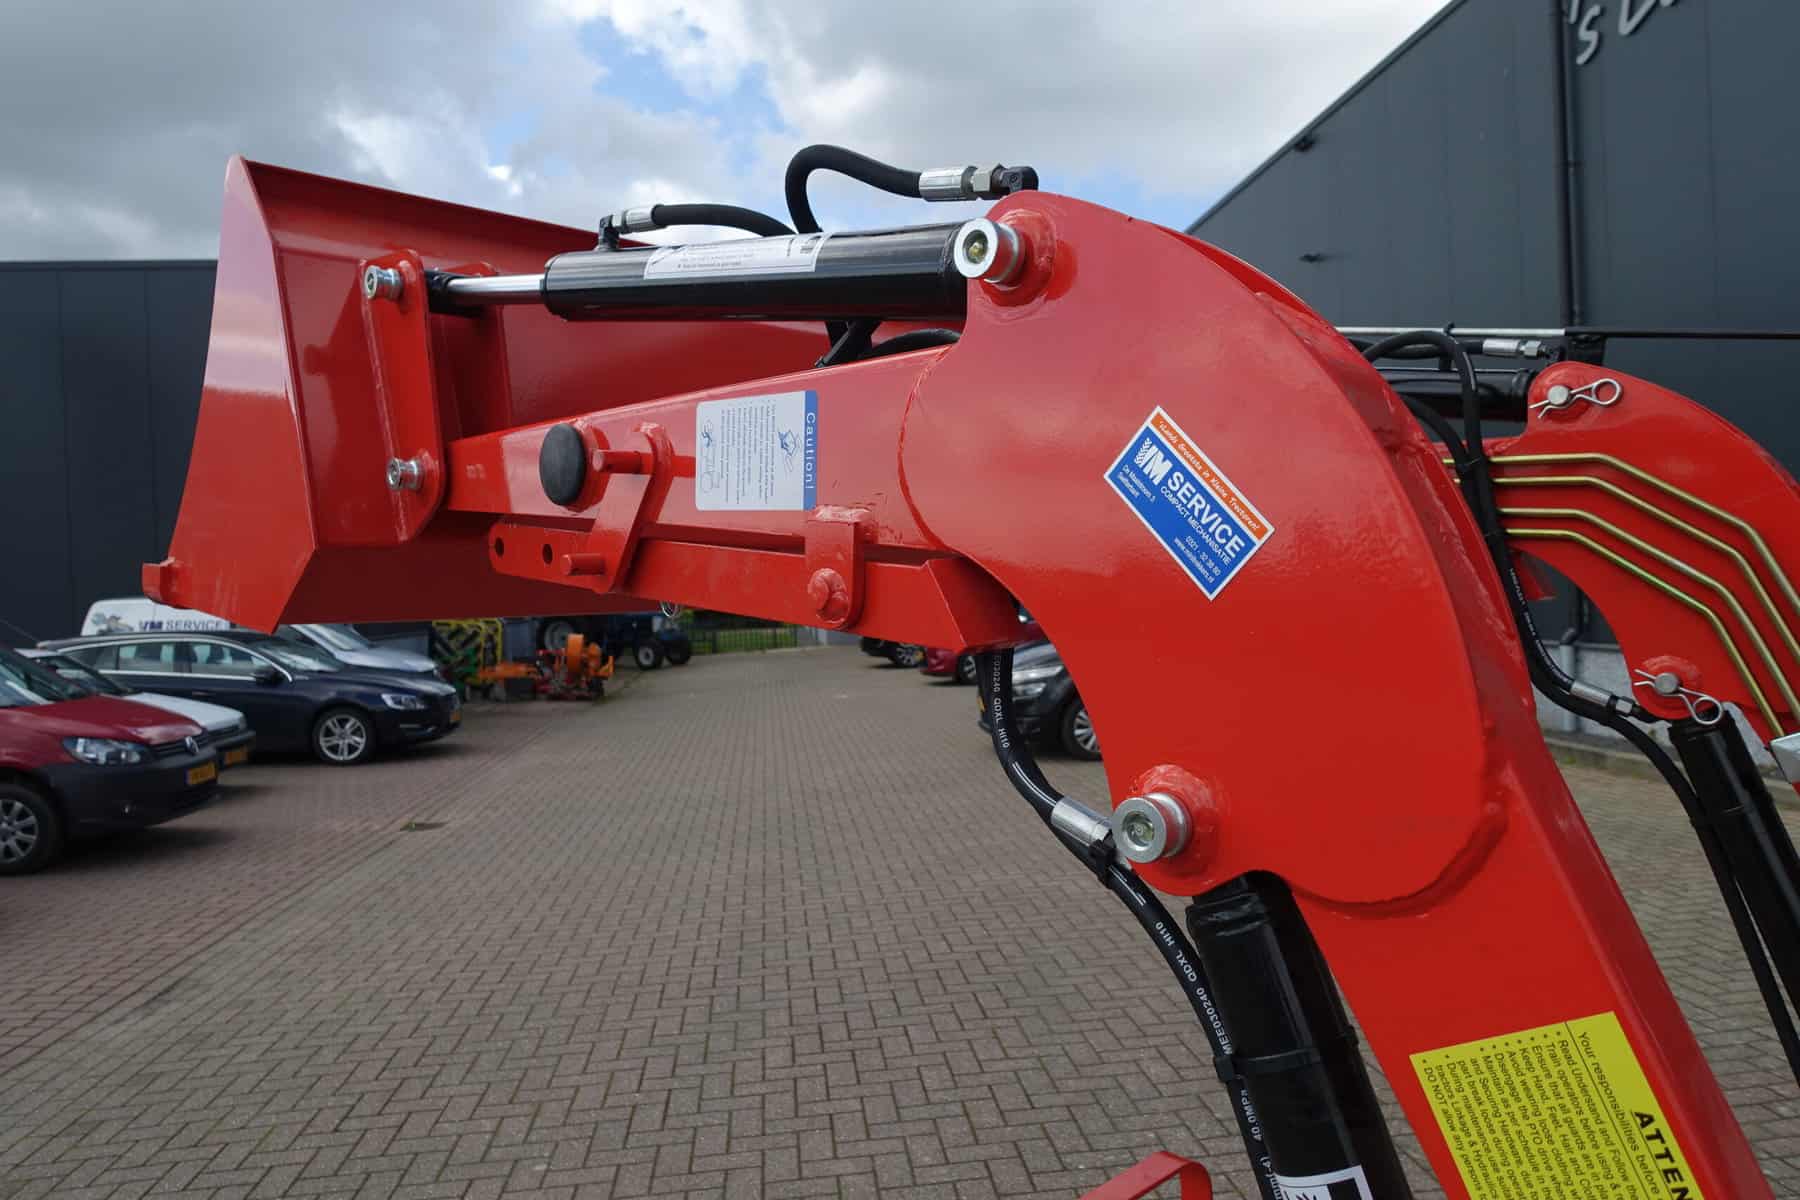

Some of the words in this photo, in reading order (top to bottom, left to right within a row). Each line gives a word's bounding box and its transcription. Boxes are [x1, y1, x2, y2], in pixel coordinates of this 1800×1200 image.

[805, 412, 816, 489] Caution!
[1159, 484, 1189, 519] COMPACT
[1186, 515, 1231, 566] MECHANISATIE
[1165, 468, 1246, 559] SERVICE
[1175, 950, 1197, 982] QDXL
[1422, 1066, 1437, 1082] DO
[1430, 1084, 1447, 1106] NOT
[1440, 1107, 1459, 1132] allow
[1469, 1057, 1485, 1075] and
[1476, 1076, 1504, 1118] Securing
[1531, 1044, 1555, 1079] Ensure
[1548, 1080, 1564, 1100] that
[1434, 1064, 1457, 1099] tractors
[1448, 1100, 1474, 1138] Linkage
[1443, 1062, 1467, 1093] During
[1459, 1094, 1493, 1153] maintenance
[1456, 1059, 1473, 1079] part
[1466, 1080, 1486, 1106] break
[1479, 1108, 1498, 1134] loose
[1489, 1135, 1512, 1167] during
[1481, 1055, 1507, 1095] Maintain
[1514, 1129, 1542, 1173] schedule
[1491, 1052, 1524, 1103] Disengage
[1517, 1104, 1532, 1121] the
[1525, 1122, 1543, 1145] PTO
[1536, 1147, 1555, 1172] drive
[1505, 1049, 1526, 1077] Avoid
[1516, 1078, 1543, 1117] wearing
[1537, 1118, 1557, 1145] loose
[1547, 1146, 1576, 1187] clothing
[1517, 1047, 1538, 1073] Keep
[1568, 1156, 1586, 1176] and
[1544, 1042, 1564, 1067] Train
[1554, 1069, 1586, 1116] operators
[1579, 1117, 1603, 1150] before
[1593, 1152, 1615, 1180] using
[1557, 1102, 1571, 1114] all
[1557, 1039, 1578, 1065] Read
[1570, 1067, 1605, 1125] Understand
[1598, 1126, 1615, 1146] and
[1608, 1148, 1632, 1182] Follow
[1562, 1116, 1588, 1151] guards
[1576, 1032, 1598, 1060] Your
[1589, 1061, 1641, 1152] responsibilities
[1634, 1153, 1662, 1195] before
[1520, 1169, 1536, 1189] due
[1581, 1152, 1596, 1170] are
